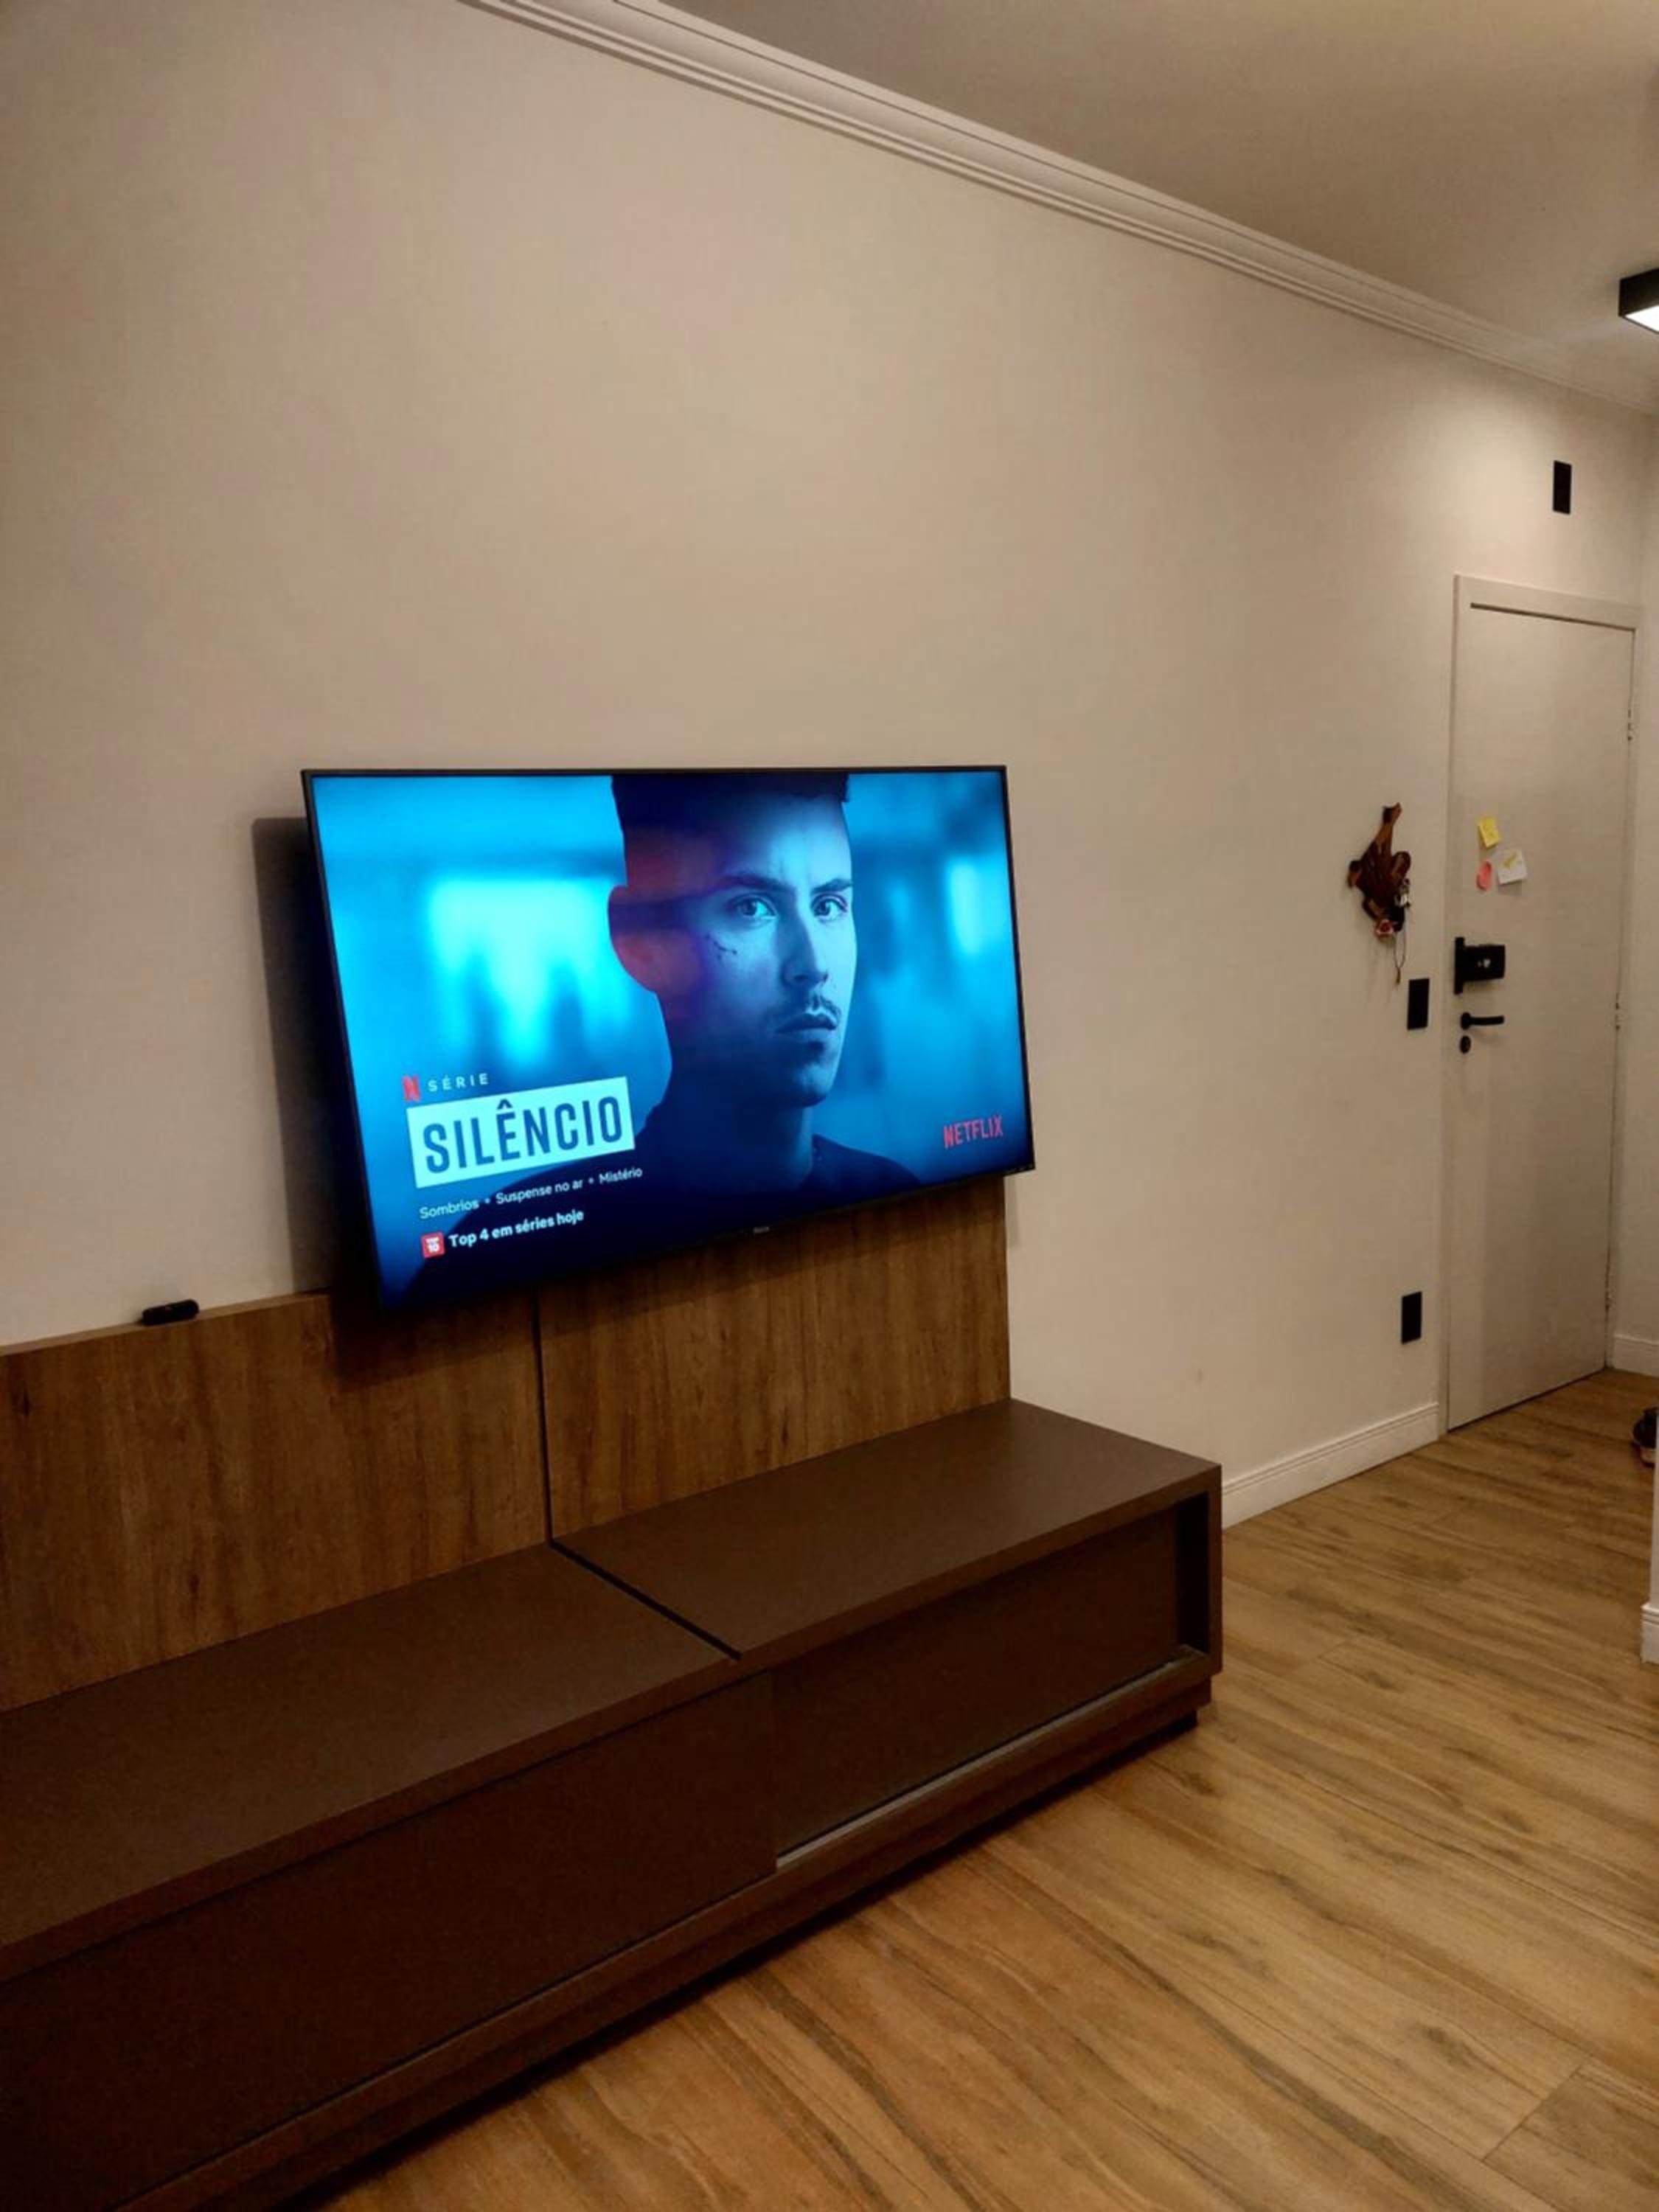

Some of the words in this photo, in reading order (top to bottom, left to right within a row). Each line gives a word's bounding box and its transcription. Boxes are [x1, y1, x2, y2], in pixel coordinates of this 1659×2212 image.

[403, 1074, 421, 1102] N
[428, 1074, 489, 1092] SÉRIE
[422, 1096, 623, 1174] SILÊNCIO
[944, 1114, 1004, 1149] NETFLIX
[419, 1199, 479, 1220] Sombrios
[495, 1185, 552, 1204] Suspense
[554, 1182, 570, 1194] no
[572, 1180, 583, 1189] ar
[599, 1166, 643, 1184] Mistério
[448, 1234, 477, 1248] Top
[479, 1228, 489, 1240] 4
[491, 1225, 513, 1239] em
[515, 1217, 555, 1234] séries
[556, 1208, 584, 1225] hoje
